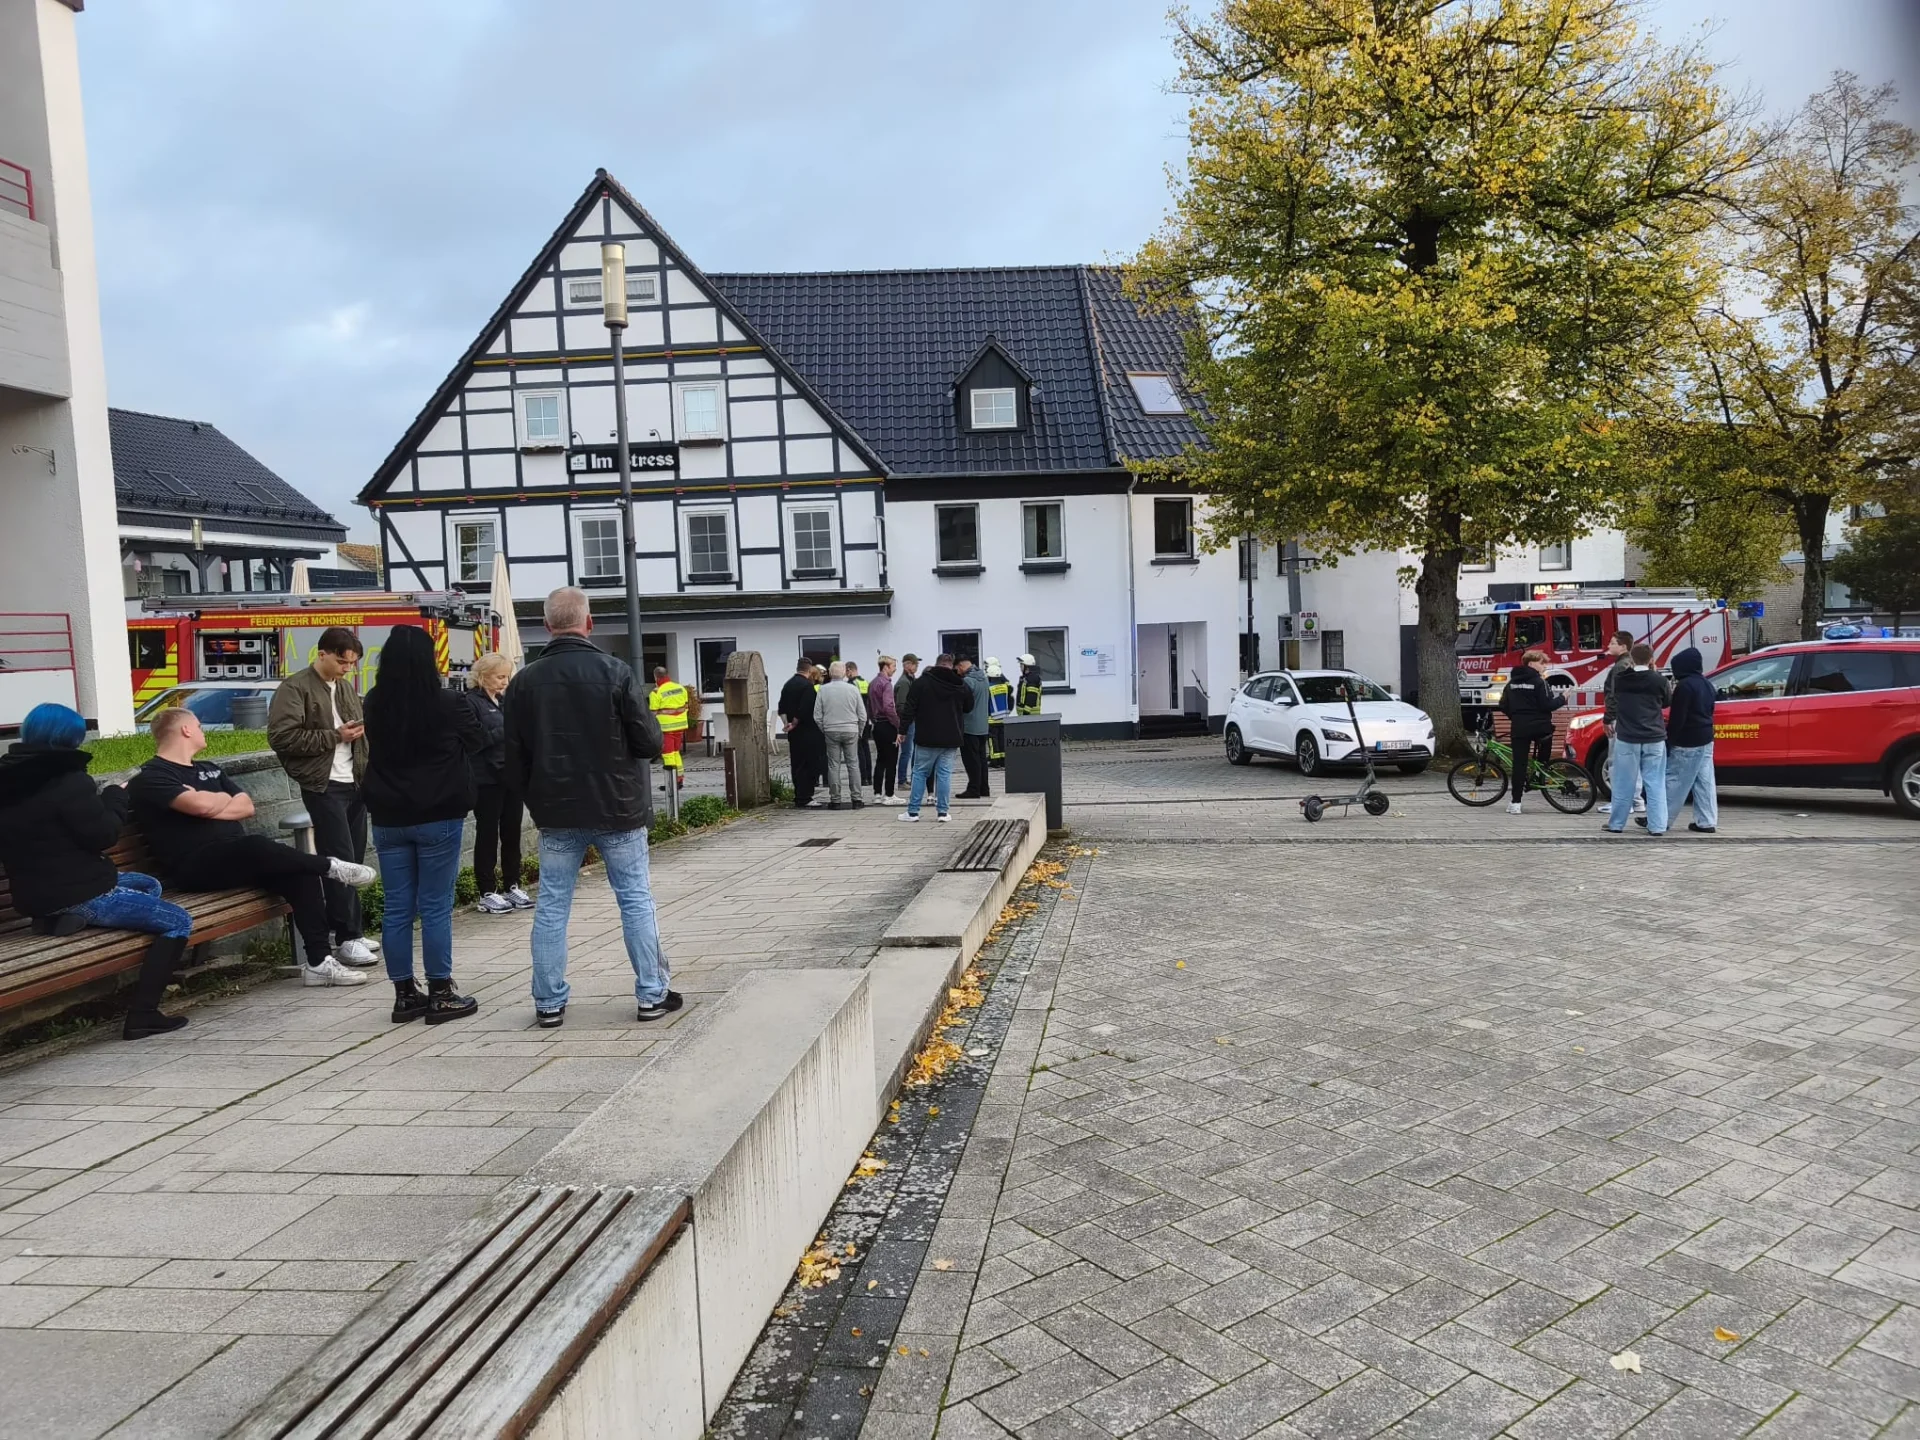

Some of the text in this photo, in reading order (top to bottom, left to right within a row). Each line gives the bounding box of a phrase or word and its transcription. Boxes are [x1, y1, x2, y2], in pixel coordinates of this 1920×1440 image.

[591, 453, 675, 469] Im tress
[250, 617, 309, 626] FEUERWEHR
[1458, 658, 1492, 670] rwehr
